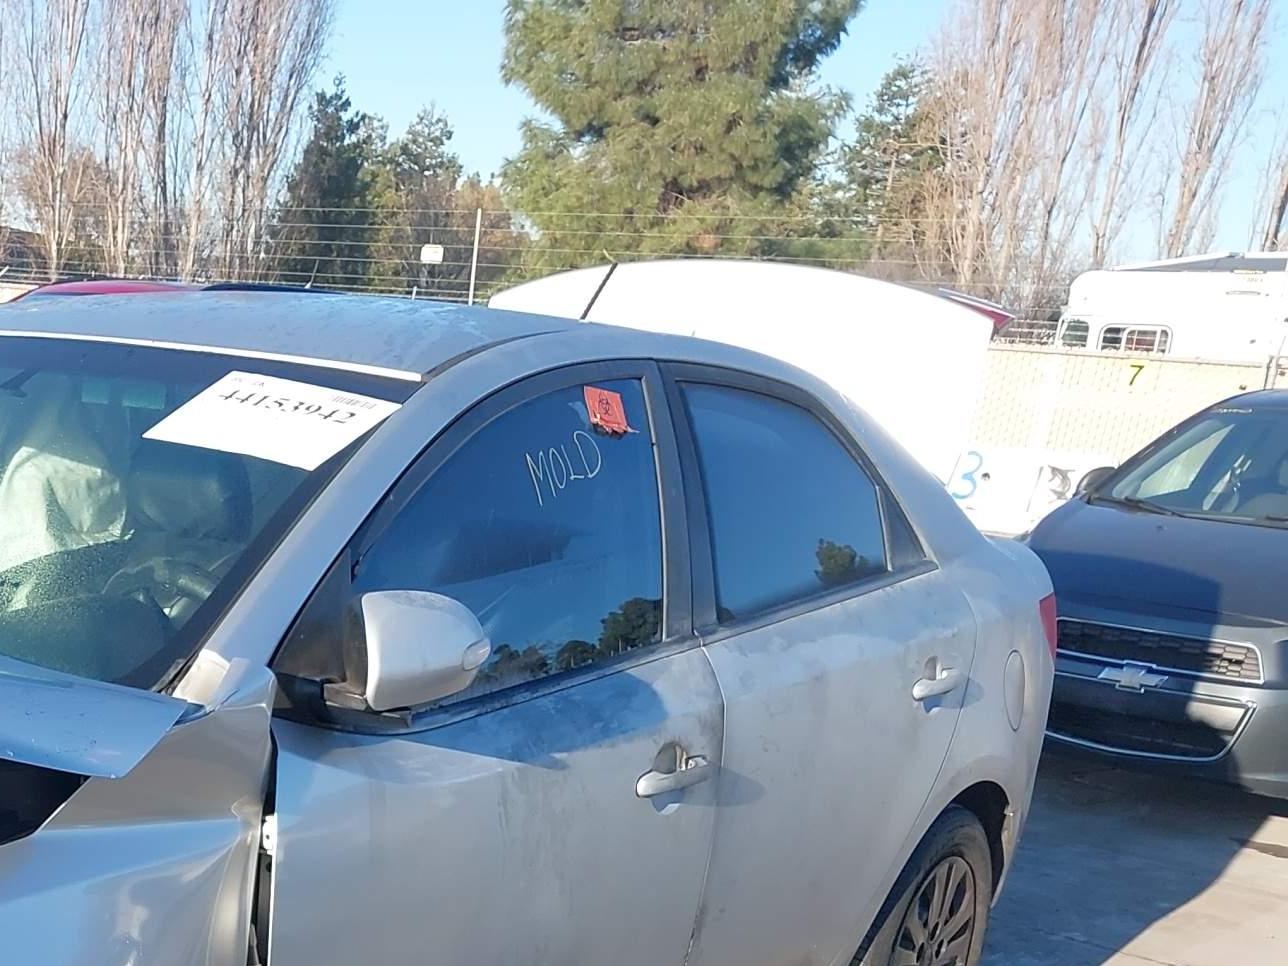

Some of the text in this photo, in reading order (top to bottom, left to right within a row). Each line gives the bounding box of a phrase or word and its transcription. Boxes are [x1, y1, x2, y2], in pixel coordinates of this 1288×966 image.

[1129, 364, 1145, 386] 7
[219, 389, 358, 425] 44153942
[525, 431, 602, 507] MOLD
[951, 450, 984, 500] 3
